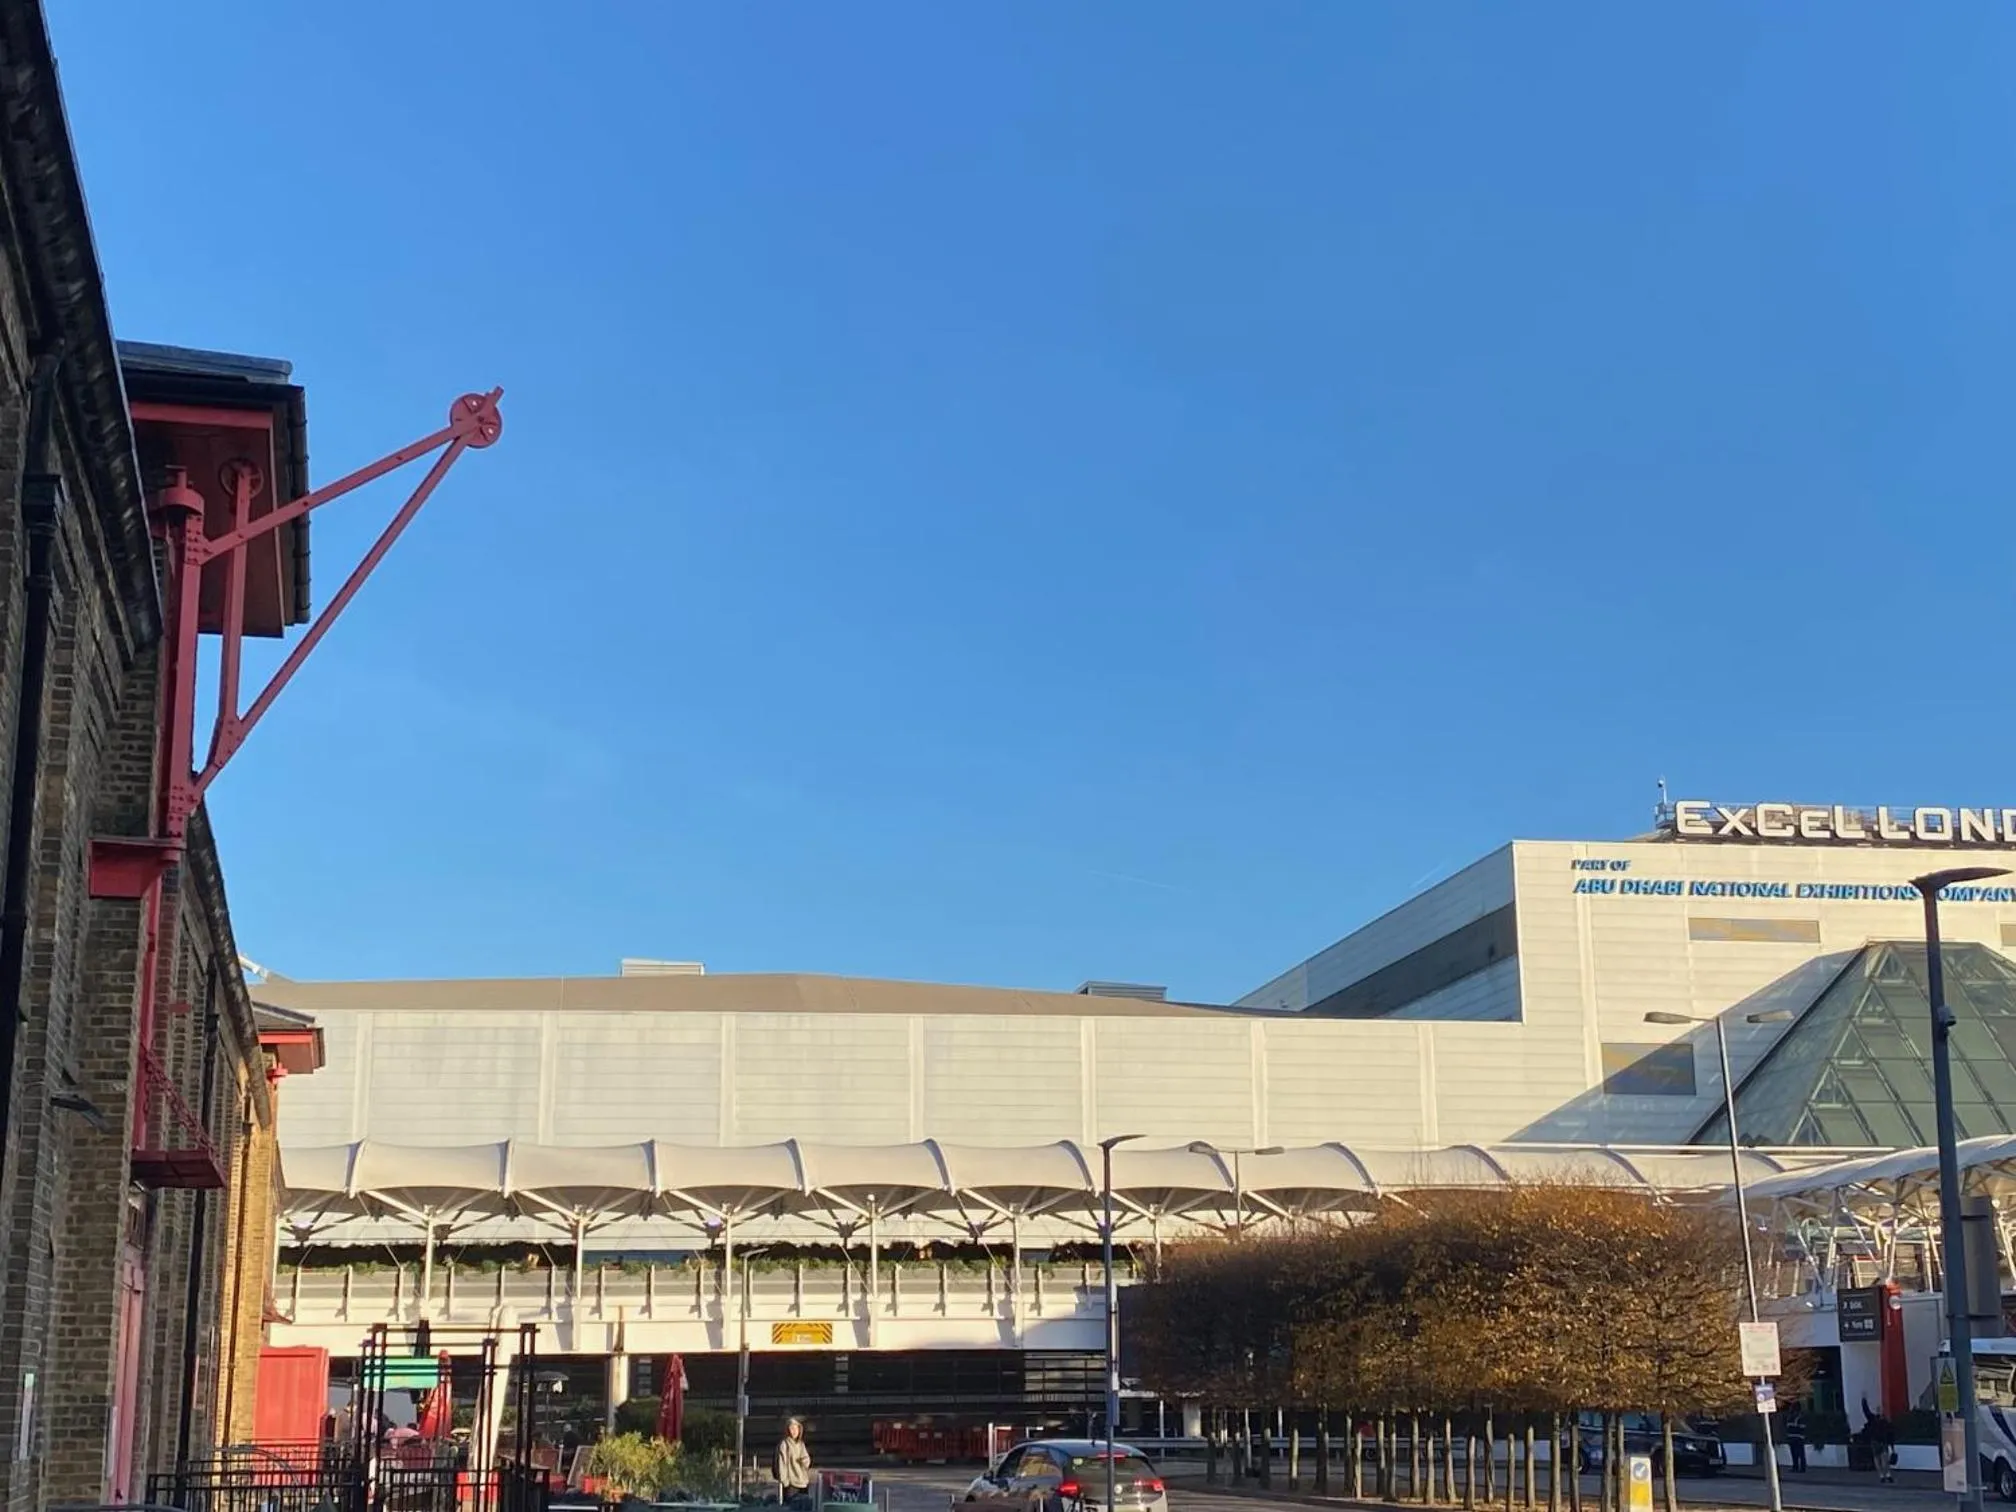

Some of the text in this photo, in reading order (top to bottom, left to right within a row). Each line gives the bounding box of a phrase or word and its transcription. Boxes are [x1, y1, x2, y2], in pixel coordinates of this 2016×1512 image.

[1571, 859, 1632, 871] PART OF
[1572, 878, 2016, 902] ABU DHABI NATIONAL EXHIBITIONS OMPANY
